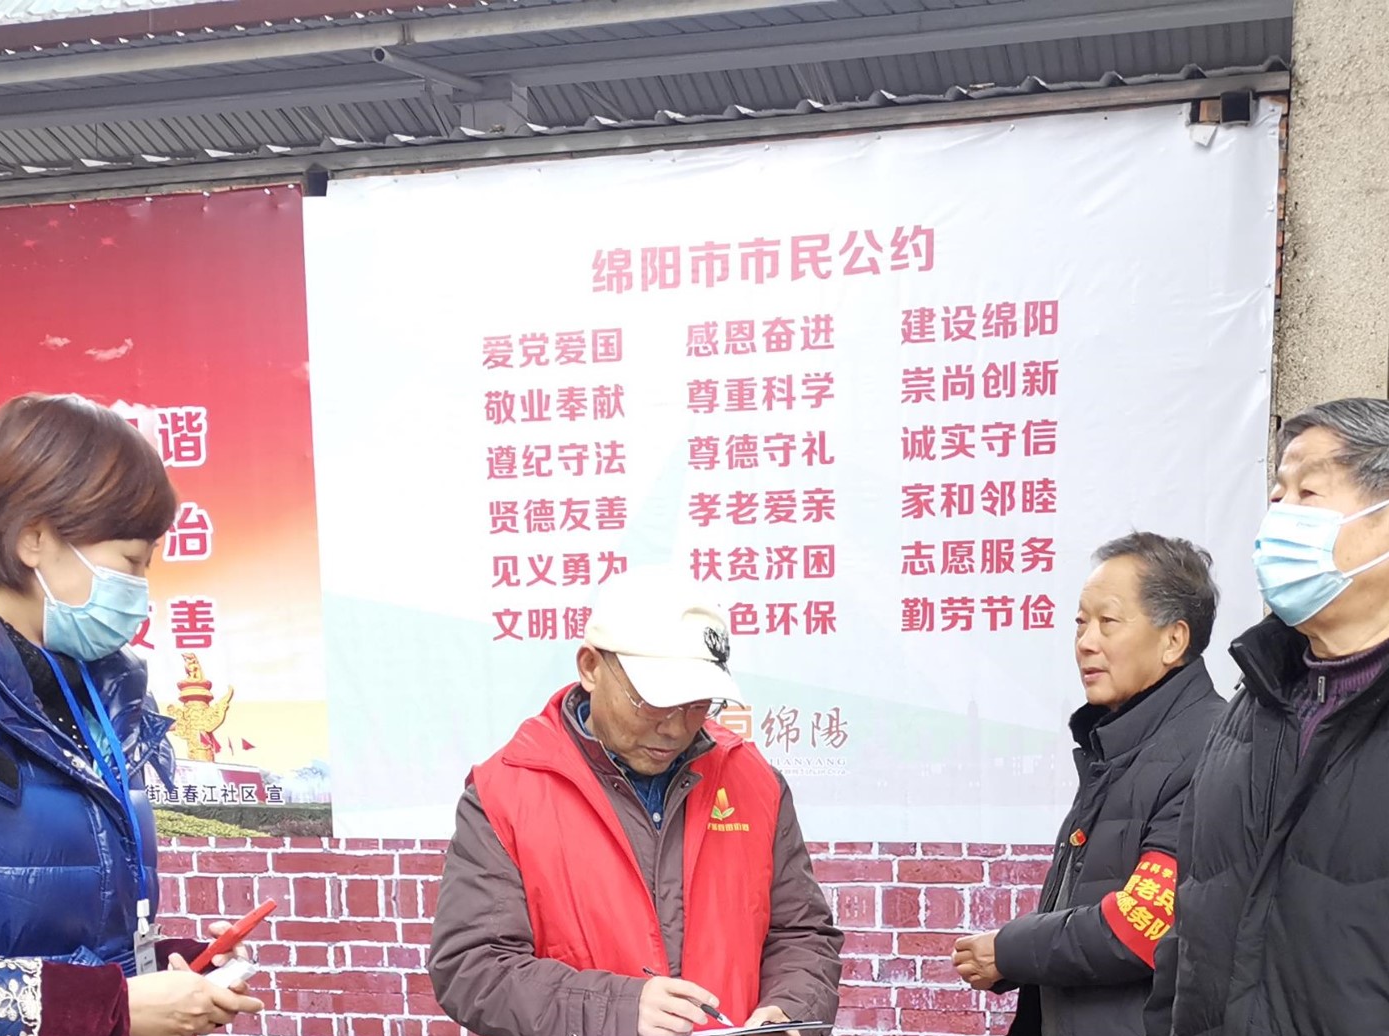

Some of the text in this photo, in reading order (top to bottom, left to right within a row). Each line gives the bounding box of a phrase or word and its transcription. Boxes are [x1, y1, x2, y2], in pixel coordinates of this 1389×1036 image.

[592, 225, 935, 294] 绵阳市市民公约
[482, 300, 1059, 369] 爱党爱国 感恩奋进 建设绵阳
[484, 360, 1059, 426] 敬业奉献 尊重科学 崇尚创新
[486, 418, 1058, 480] 遵纪守法 尊德守礼 诚实守信
[488, 478, 1057, 535] 贤德友善 孝老爱亲 家和邻睦
[491, 535, 1056, 588] 见义勇为 扶贫济困 志愿服务
[492, 593, 1056, 641] 文明健 色环保 勤劳节俭
[770, 757, 847, 767] IANYANG
[146, 785, 284, 804] 街道春江社区 宣
